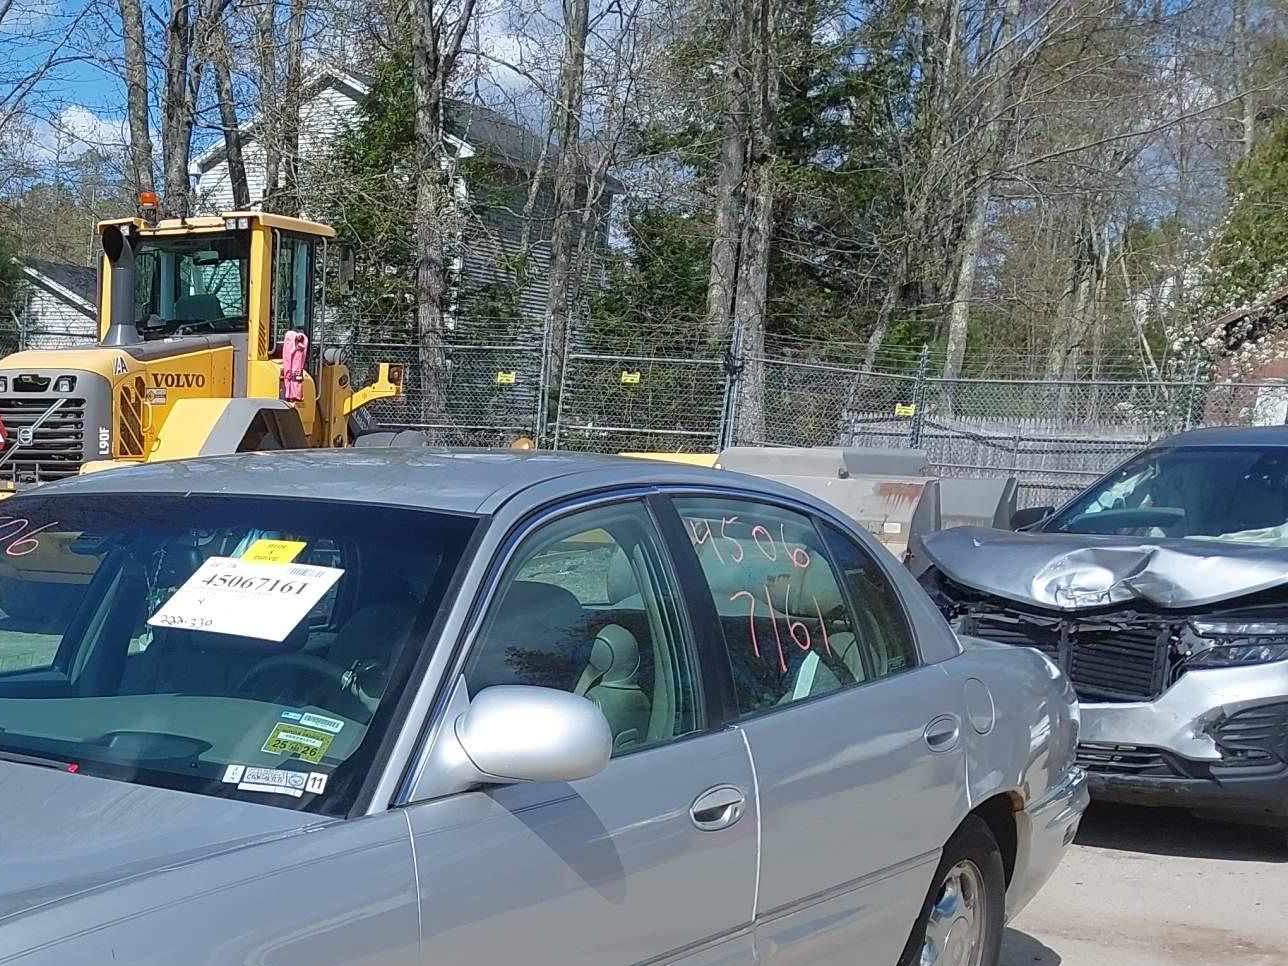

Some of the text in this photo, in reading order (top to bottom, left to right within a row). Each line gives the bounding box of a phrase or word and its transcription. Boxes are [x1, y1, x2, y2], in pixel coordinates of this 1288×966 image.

[152, 373, 206, 388] VOLVO
[98, 426, 110, 455] L90F
[689, 515, 811, 568] 4506
[201, 573, 311, 595] 45067161
[729, 584, 833, 673] 7161
[271, 739, 289, 750] 25
[301, 745, 319, 757] 26
[310, 776, 324, 790] 11
